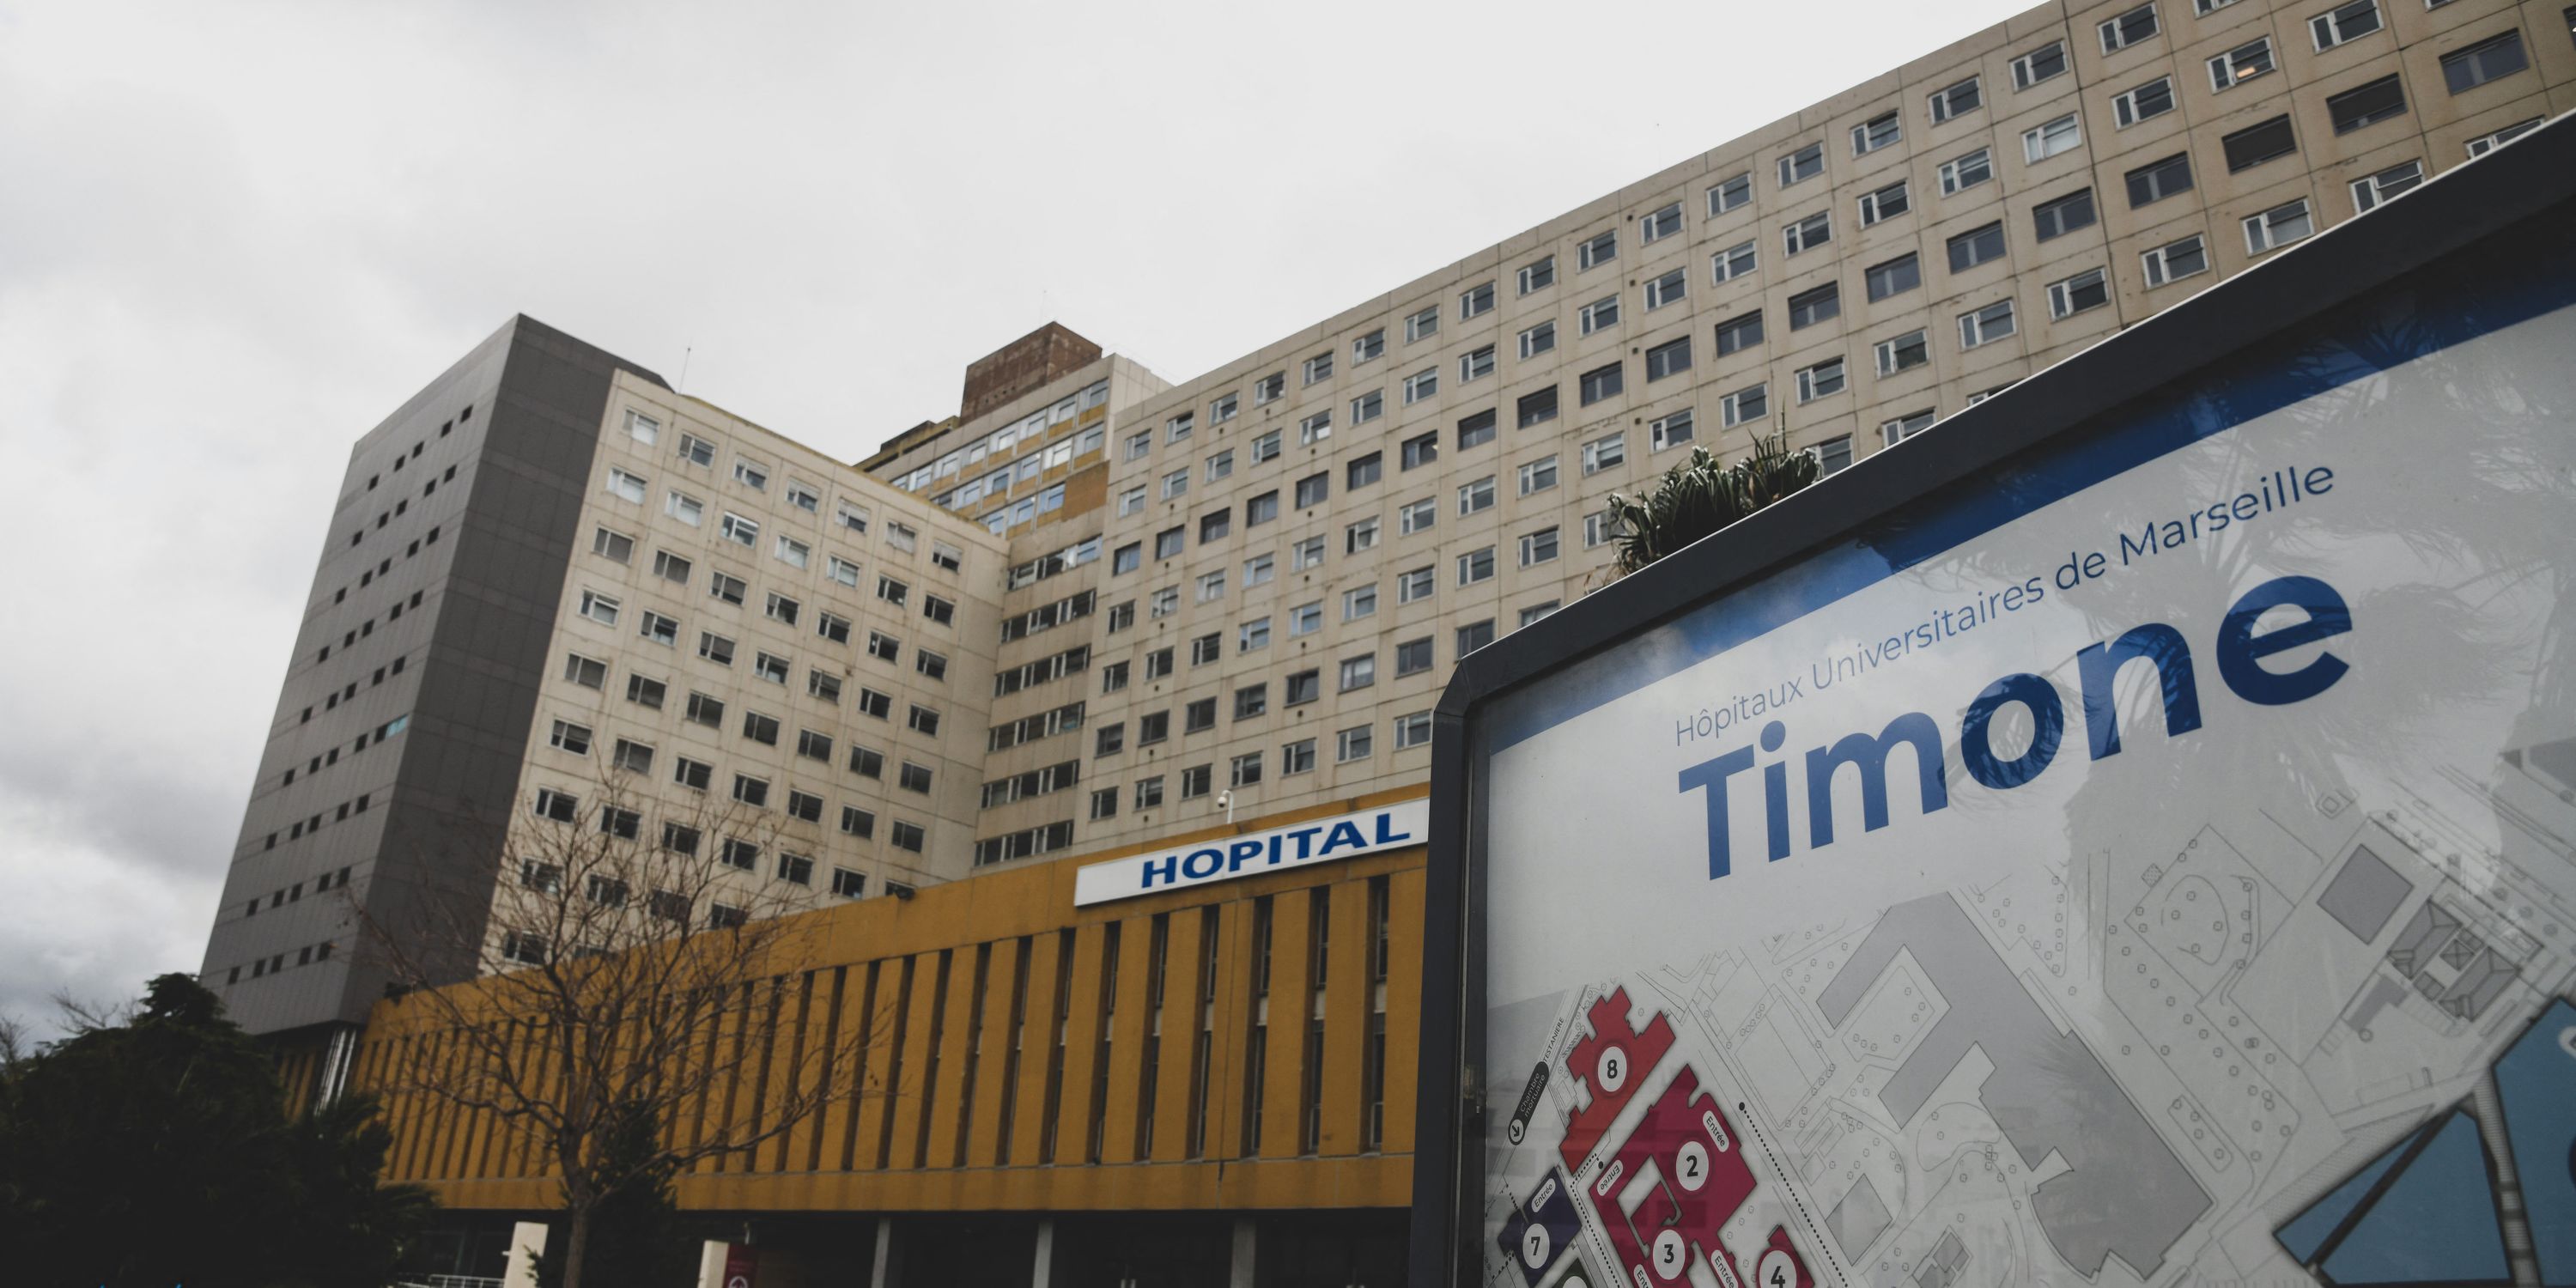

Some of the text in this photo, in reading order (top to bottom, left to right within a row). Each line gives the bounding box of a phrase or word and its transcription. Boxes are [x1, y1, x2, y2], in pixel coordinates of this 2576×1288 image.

[1675, 465, 2335, 747] Hôpitaux Universitaires de Marseille
[1678, 575, 2353, 881] Timone
[1141, 813, 1411, 888] HOPITAL
[1543, 1017, 1564, 1063] TESTANIERE
[1607, 1059, 1618, 1079] 8
[1520, 1072, 1540, 1112] Chambre
[1524, 1074, 1546, 1119] mortuaire
[1705, 1116, 1726, 1147] Entrée
[1600, 1164, 1620, 1190] Entrée
[1686, 1155, 1698, 1177] 2
[1534, 1183, 1553, 1208] Entrée
[1530, 1236, 1540, 1256] 7
[1664, 1243, 1674, 1264] 3
[1771, 1266, 1786, 1288] 4
